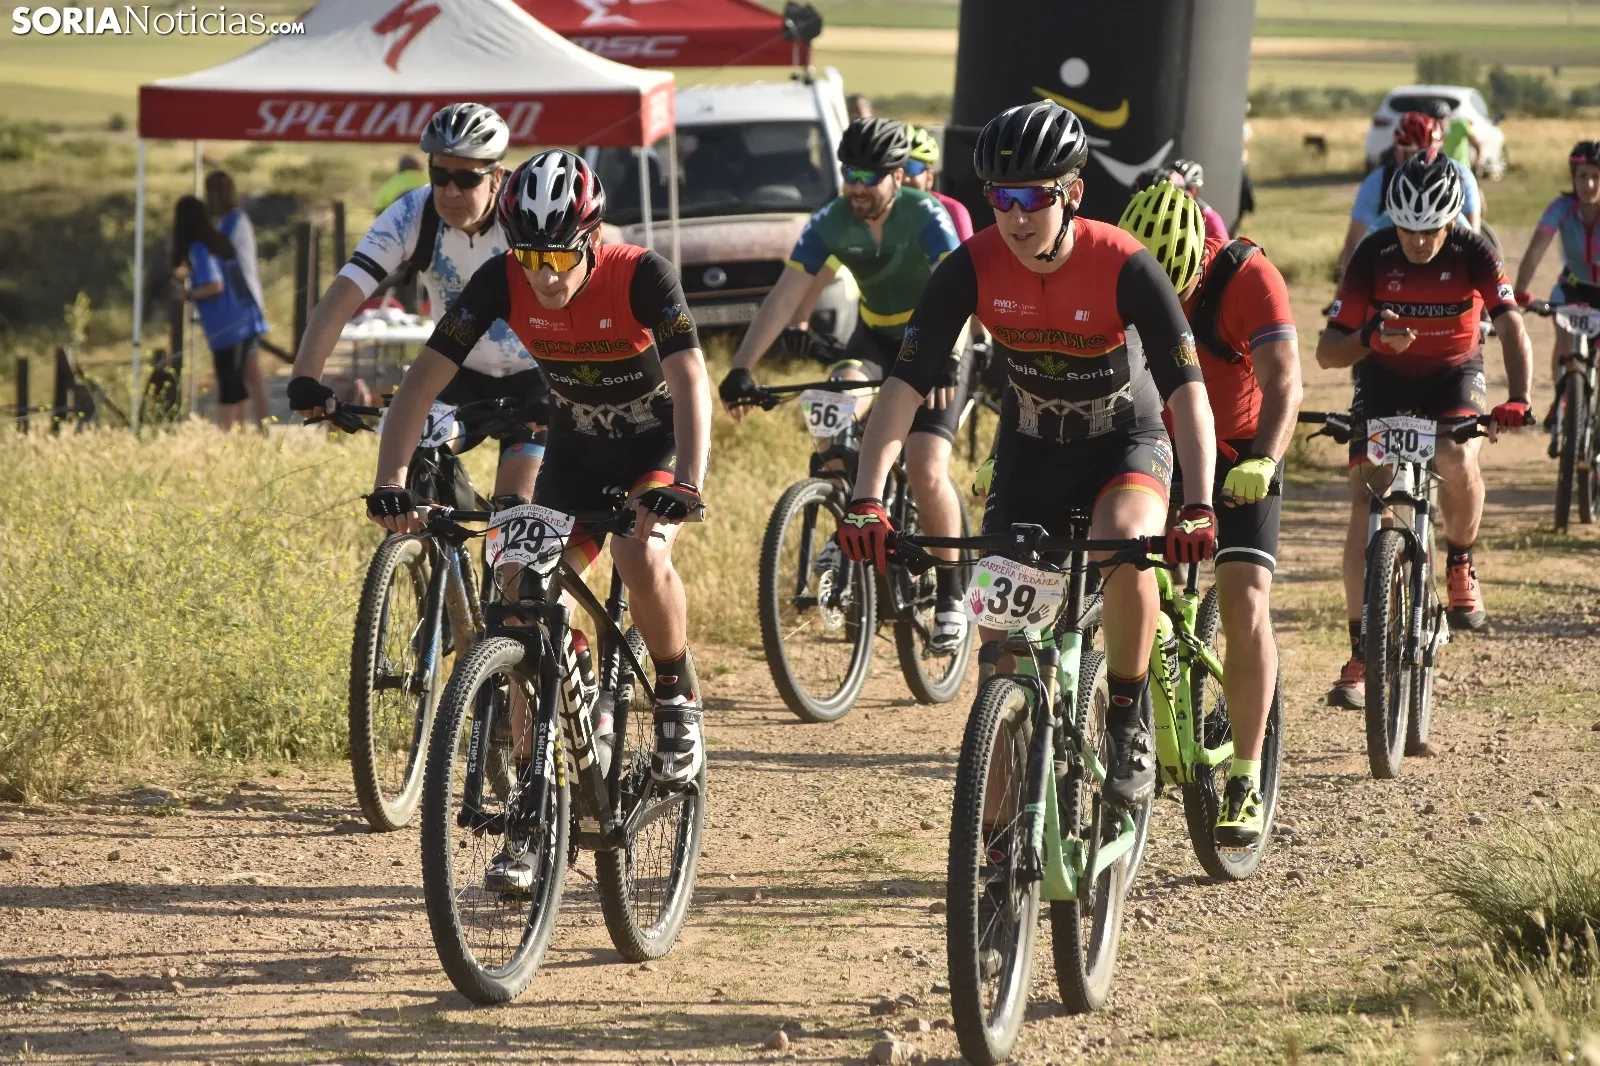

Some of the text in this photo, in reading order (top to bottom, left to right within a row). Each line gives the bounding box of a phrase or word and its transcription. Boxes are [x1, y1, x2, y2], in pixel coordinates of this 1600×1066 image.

[247, 99, 544, 138] SPECIALD
[549, 370, 644, 386] Caja Soria
[1007, 357, 1038, 376] Caja
[1066, 368, 1115, 381] Soria
[809, 401, 840, 428] 56
[1381, 428, 1419, 454] 130
[500, 519, 546, 554] 129
[1018, 571, 1060, 586] PEDANEA
[987, 576, 1037, 618] 39
[535, 722, 547, 775] RHYTHM 32
